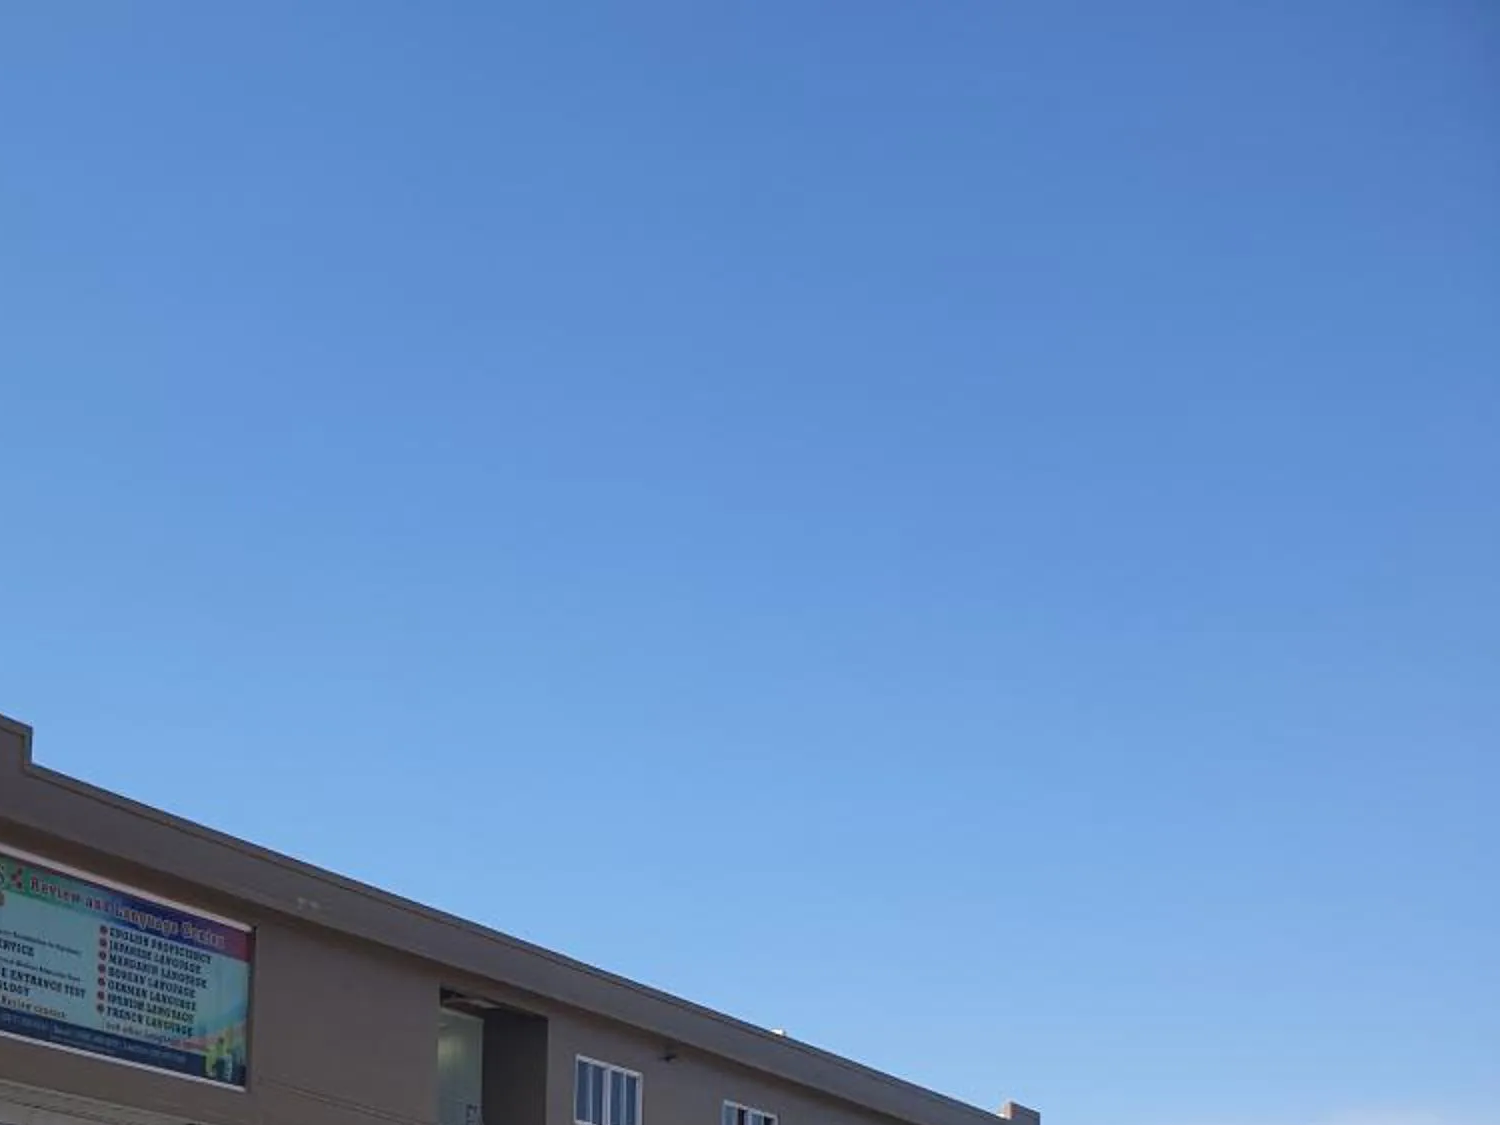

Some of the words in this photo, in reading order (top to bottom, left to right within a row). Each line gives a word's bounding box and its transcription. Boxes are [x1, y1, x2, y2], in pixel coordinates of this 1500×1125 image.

[31, 875, 80, 903] Review
[10, 969, 62, 992] ENTRANCE
[65, 984, 86, 999] TEST
[108, 981, 147, 998] GERMAN
[150, 992, 196, 1011] LANGUAGE
[107, 1007, 144, 1024] FRENCH
